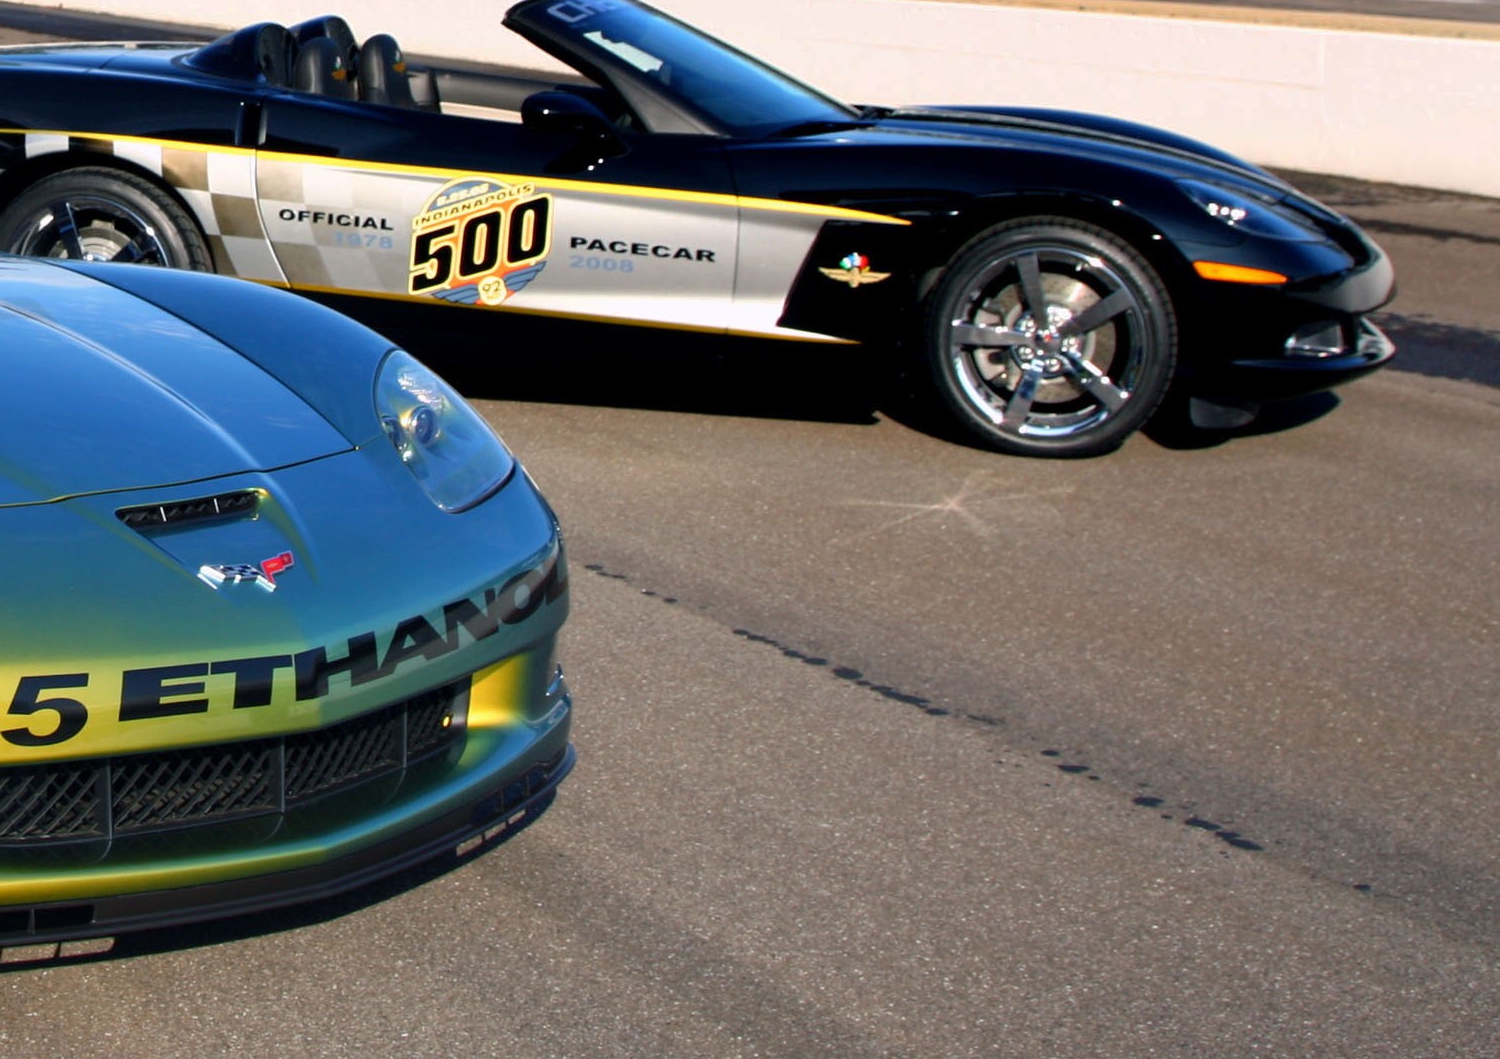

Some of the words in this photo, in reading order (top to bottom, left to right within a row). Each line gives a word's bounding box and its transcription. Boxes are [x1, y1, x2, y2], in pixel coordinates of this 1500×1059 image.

[414, 184, 532, 227] INDIANAPOLIS
[279, 208, 394, 231] OFFICIAL
[334, 232, 394, 250] 1978
[411, 195, 550, 293] 500
[570, 236, 717, 263] PACECAR
[569, 255, 634, 273] 2008
[118, 560, 567, 721] ETHANOL
